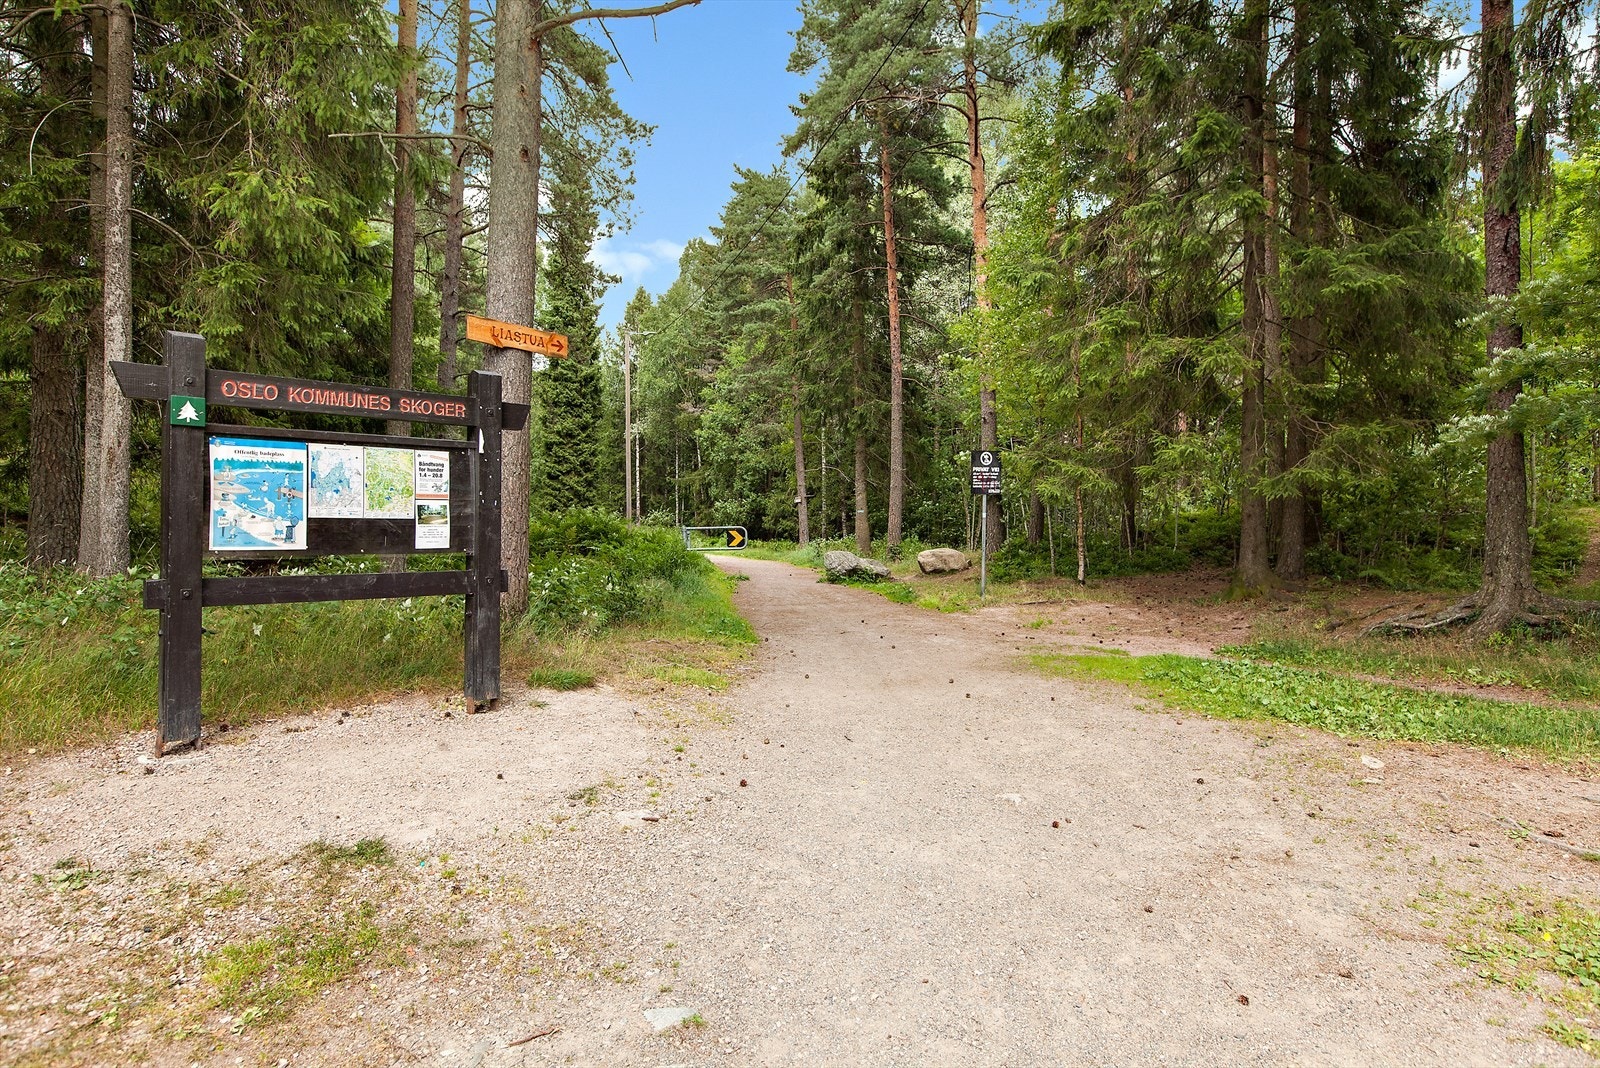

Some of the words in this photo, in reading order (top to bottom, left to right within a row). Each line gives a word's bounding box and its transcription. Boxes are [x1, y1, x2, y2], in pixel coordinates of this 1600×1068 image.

[491, 325, 545, 348] LIASTUA
[221, 379, 279, 401] OSLO
[288, 386, 391, 411] KOMMUNES
[399, 398, 466, 418] SKOGER
